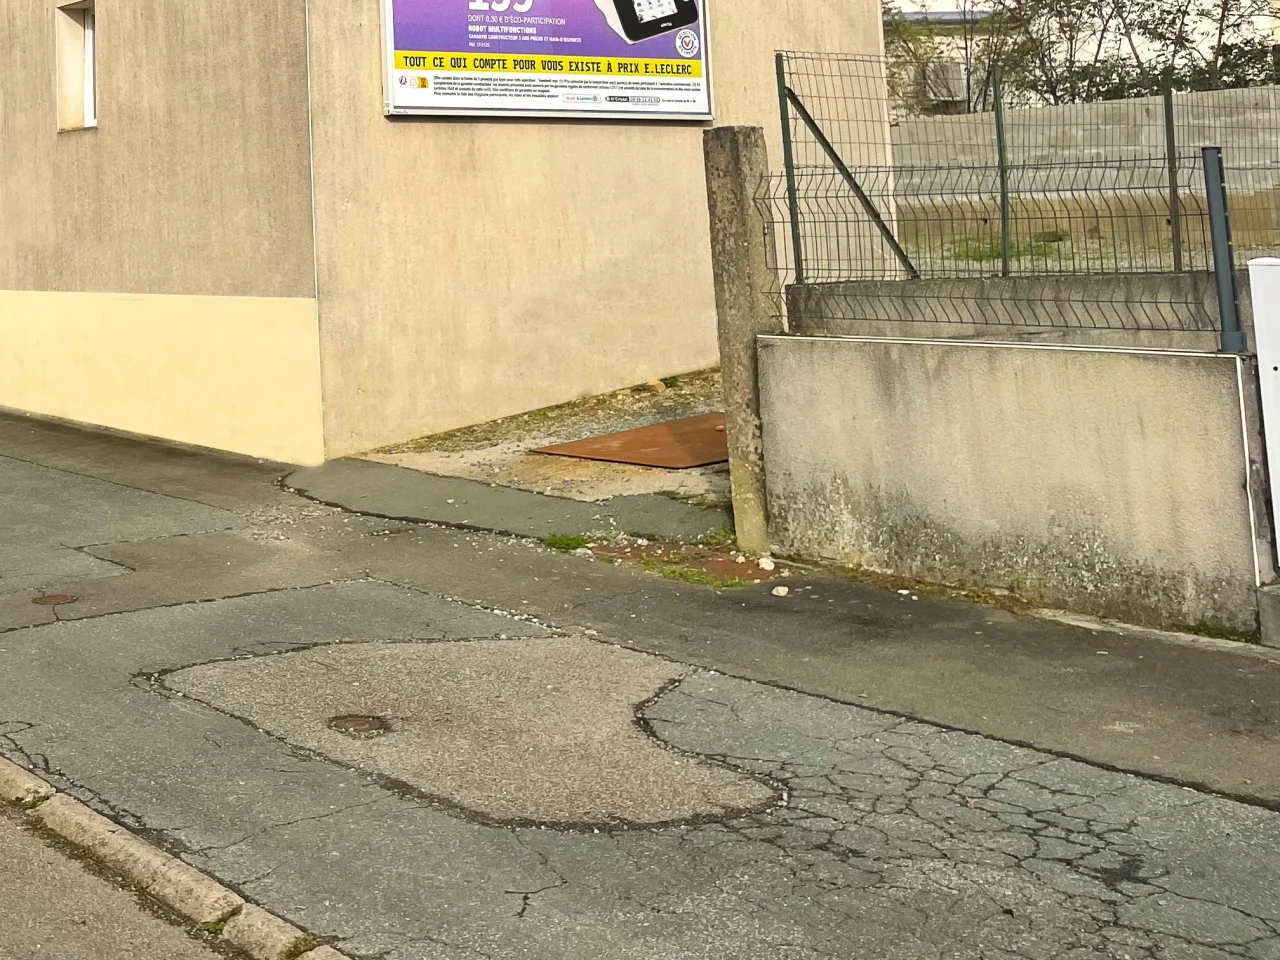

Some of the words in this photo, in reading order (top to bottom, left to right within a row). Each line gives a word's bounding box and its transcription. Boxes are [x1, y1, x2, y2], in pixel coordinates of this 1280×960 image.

[468, 14, 486, 23] DONT
[468, 25, 487, 33] ROBOT
[488, 25, 537, 34] MULTIFONCTIONS
[403, 56, 427, 67] TOUT
[433, 57, 445, 68] CE
[450, 57, 467, 68] QUI
[473, 58, 507, 70] COMPTE
[513, 59, 536, 70] POUR
[541, 60, 564, 71] VOUS
[569, 61, 601, 73] EXISTE
[607, 60, 613, 73] À
[618, 63, 640, 74] PRIX
[645, 63, 692, 75] E.LECLERC
